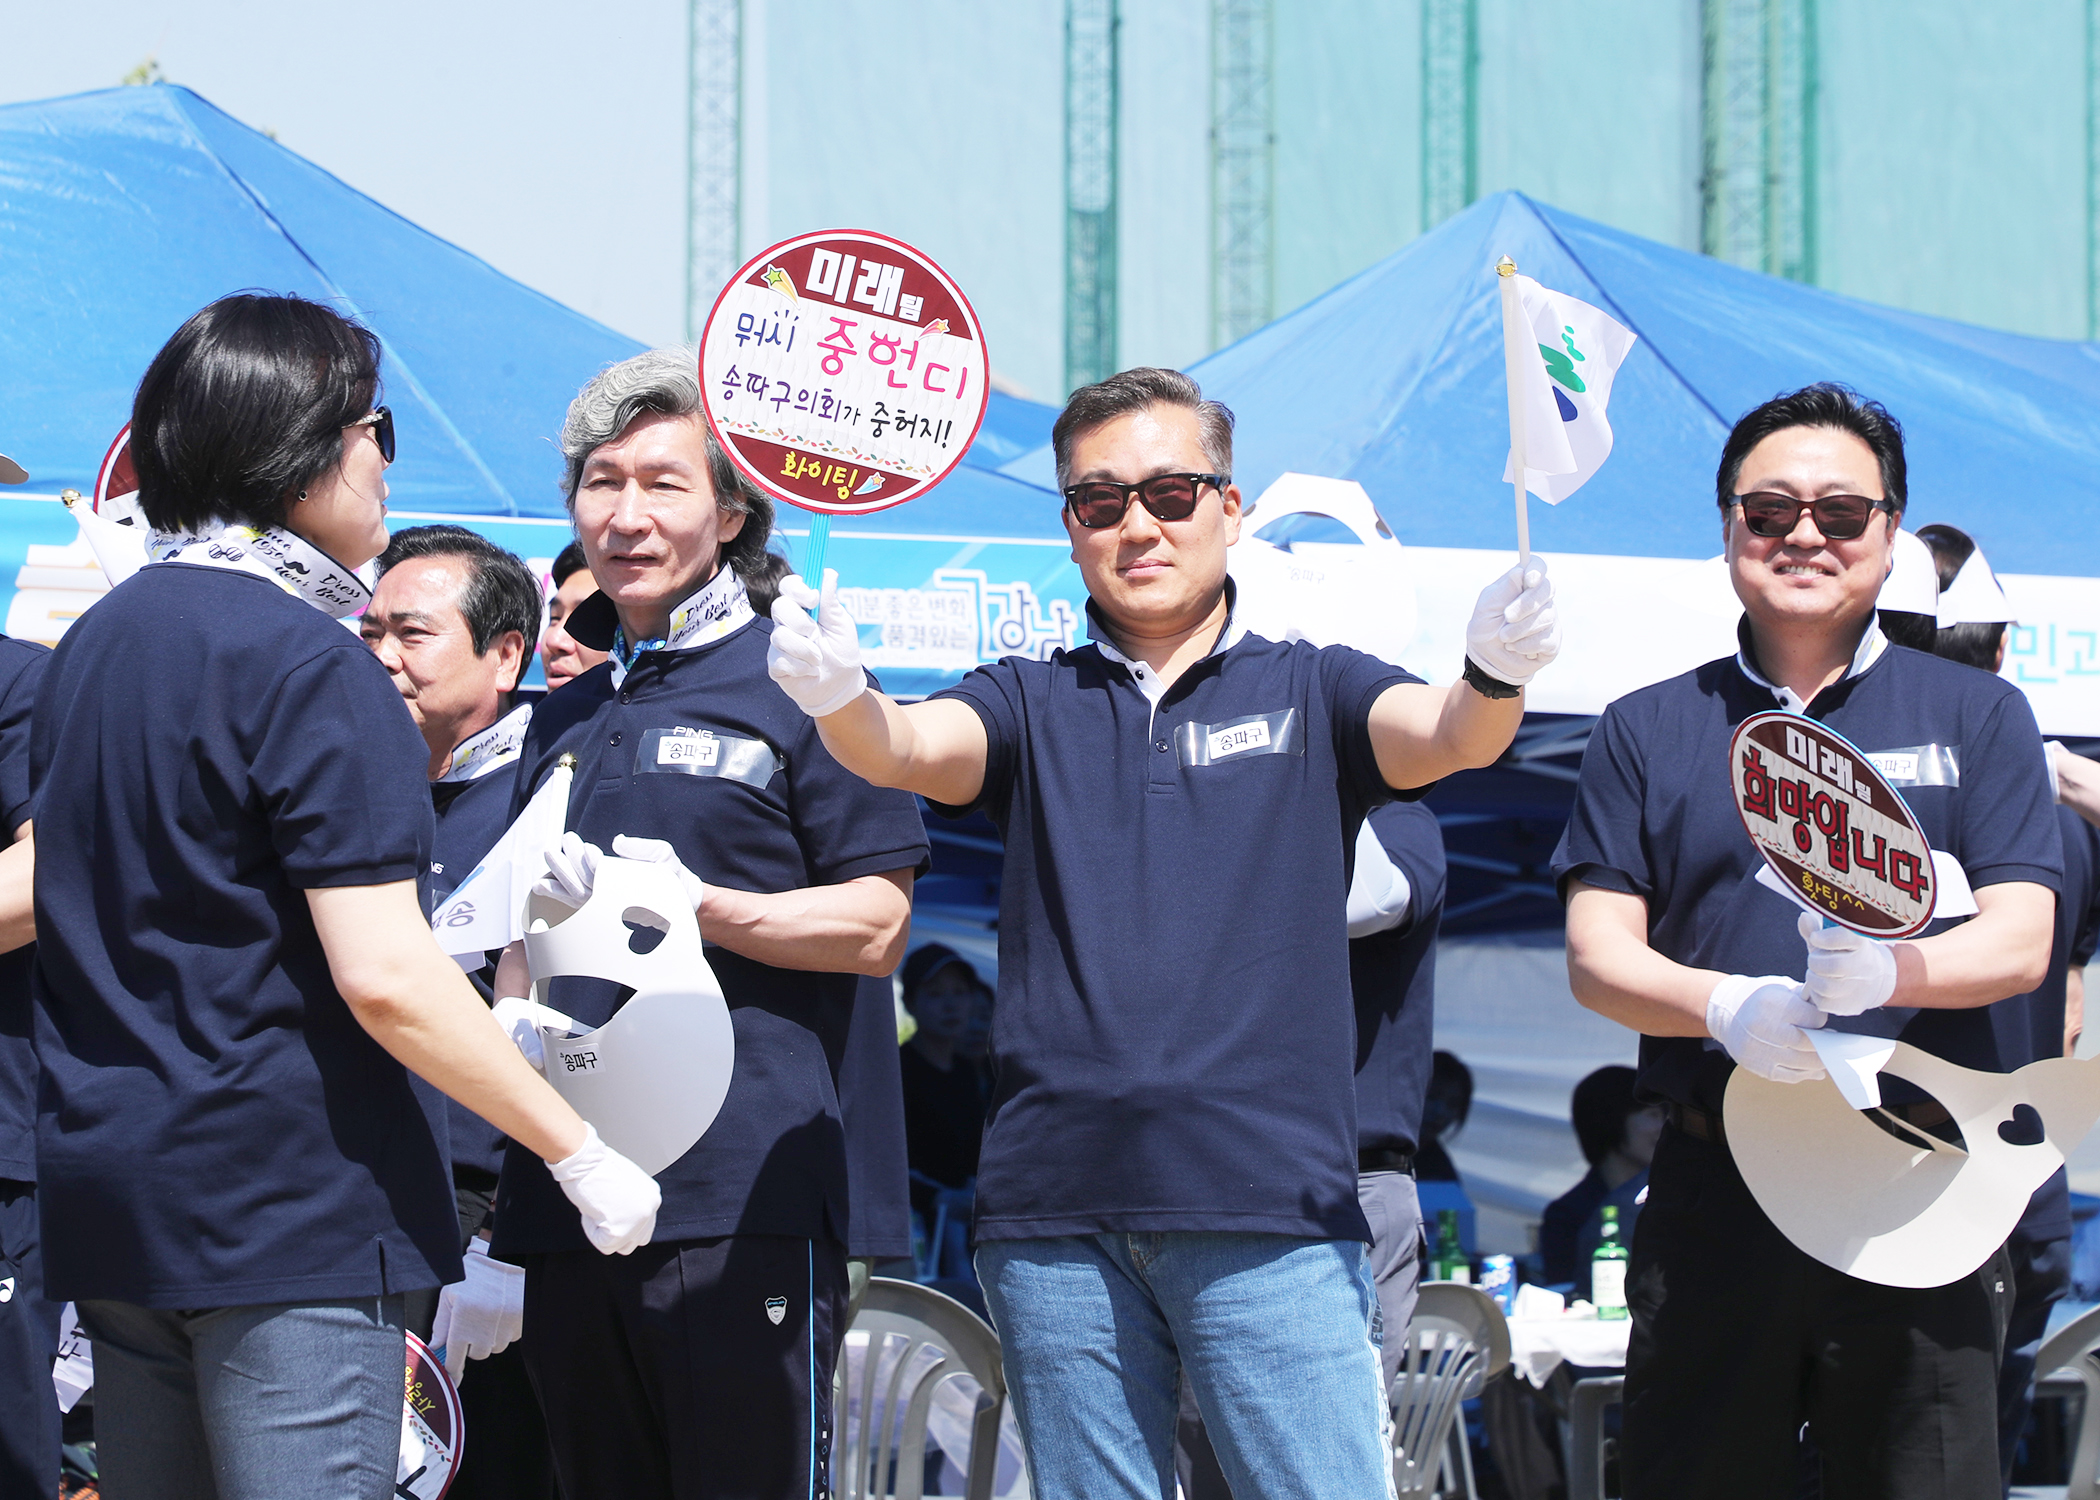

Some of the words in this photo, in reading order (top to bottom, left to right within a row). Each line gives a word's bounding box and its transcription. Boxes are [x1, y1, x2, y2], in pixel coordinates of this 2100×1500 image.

[805, 247, 924, 323] 미래팀
[735, 312, 796, 353] 뭐시
[817, 316, 968, 400] 중헌디
[870, 401, 953, 449] 중허지!
[780, 451, 859, 500] 화이팅
[251, 537, 285, 561] 1959
[315, 587, 351, 607] Best
[319, 573, 360, 599] Dress
[685, 591, 714, 624] Dress
[673, 726, 714, 740] PING
[1220, 727, 1263, 751] 송파구
[669, 742, 712, 761] 송파구
[1786, 725, 1872, 805] 미래팀
[1742, 743, 1930, 905] 희망입니다
[564, 1051, 598, 1072] 송파구
